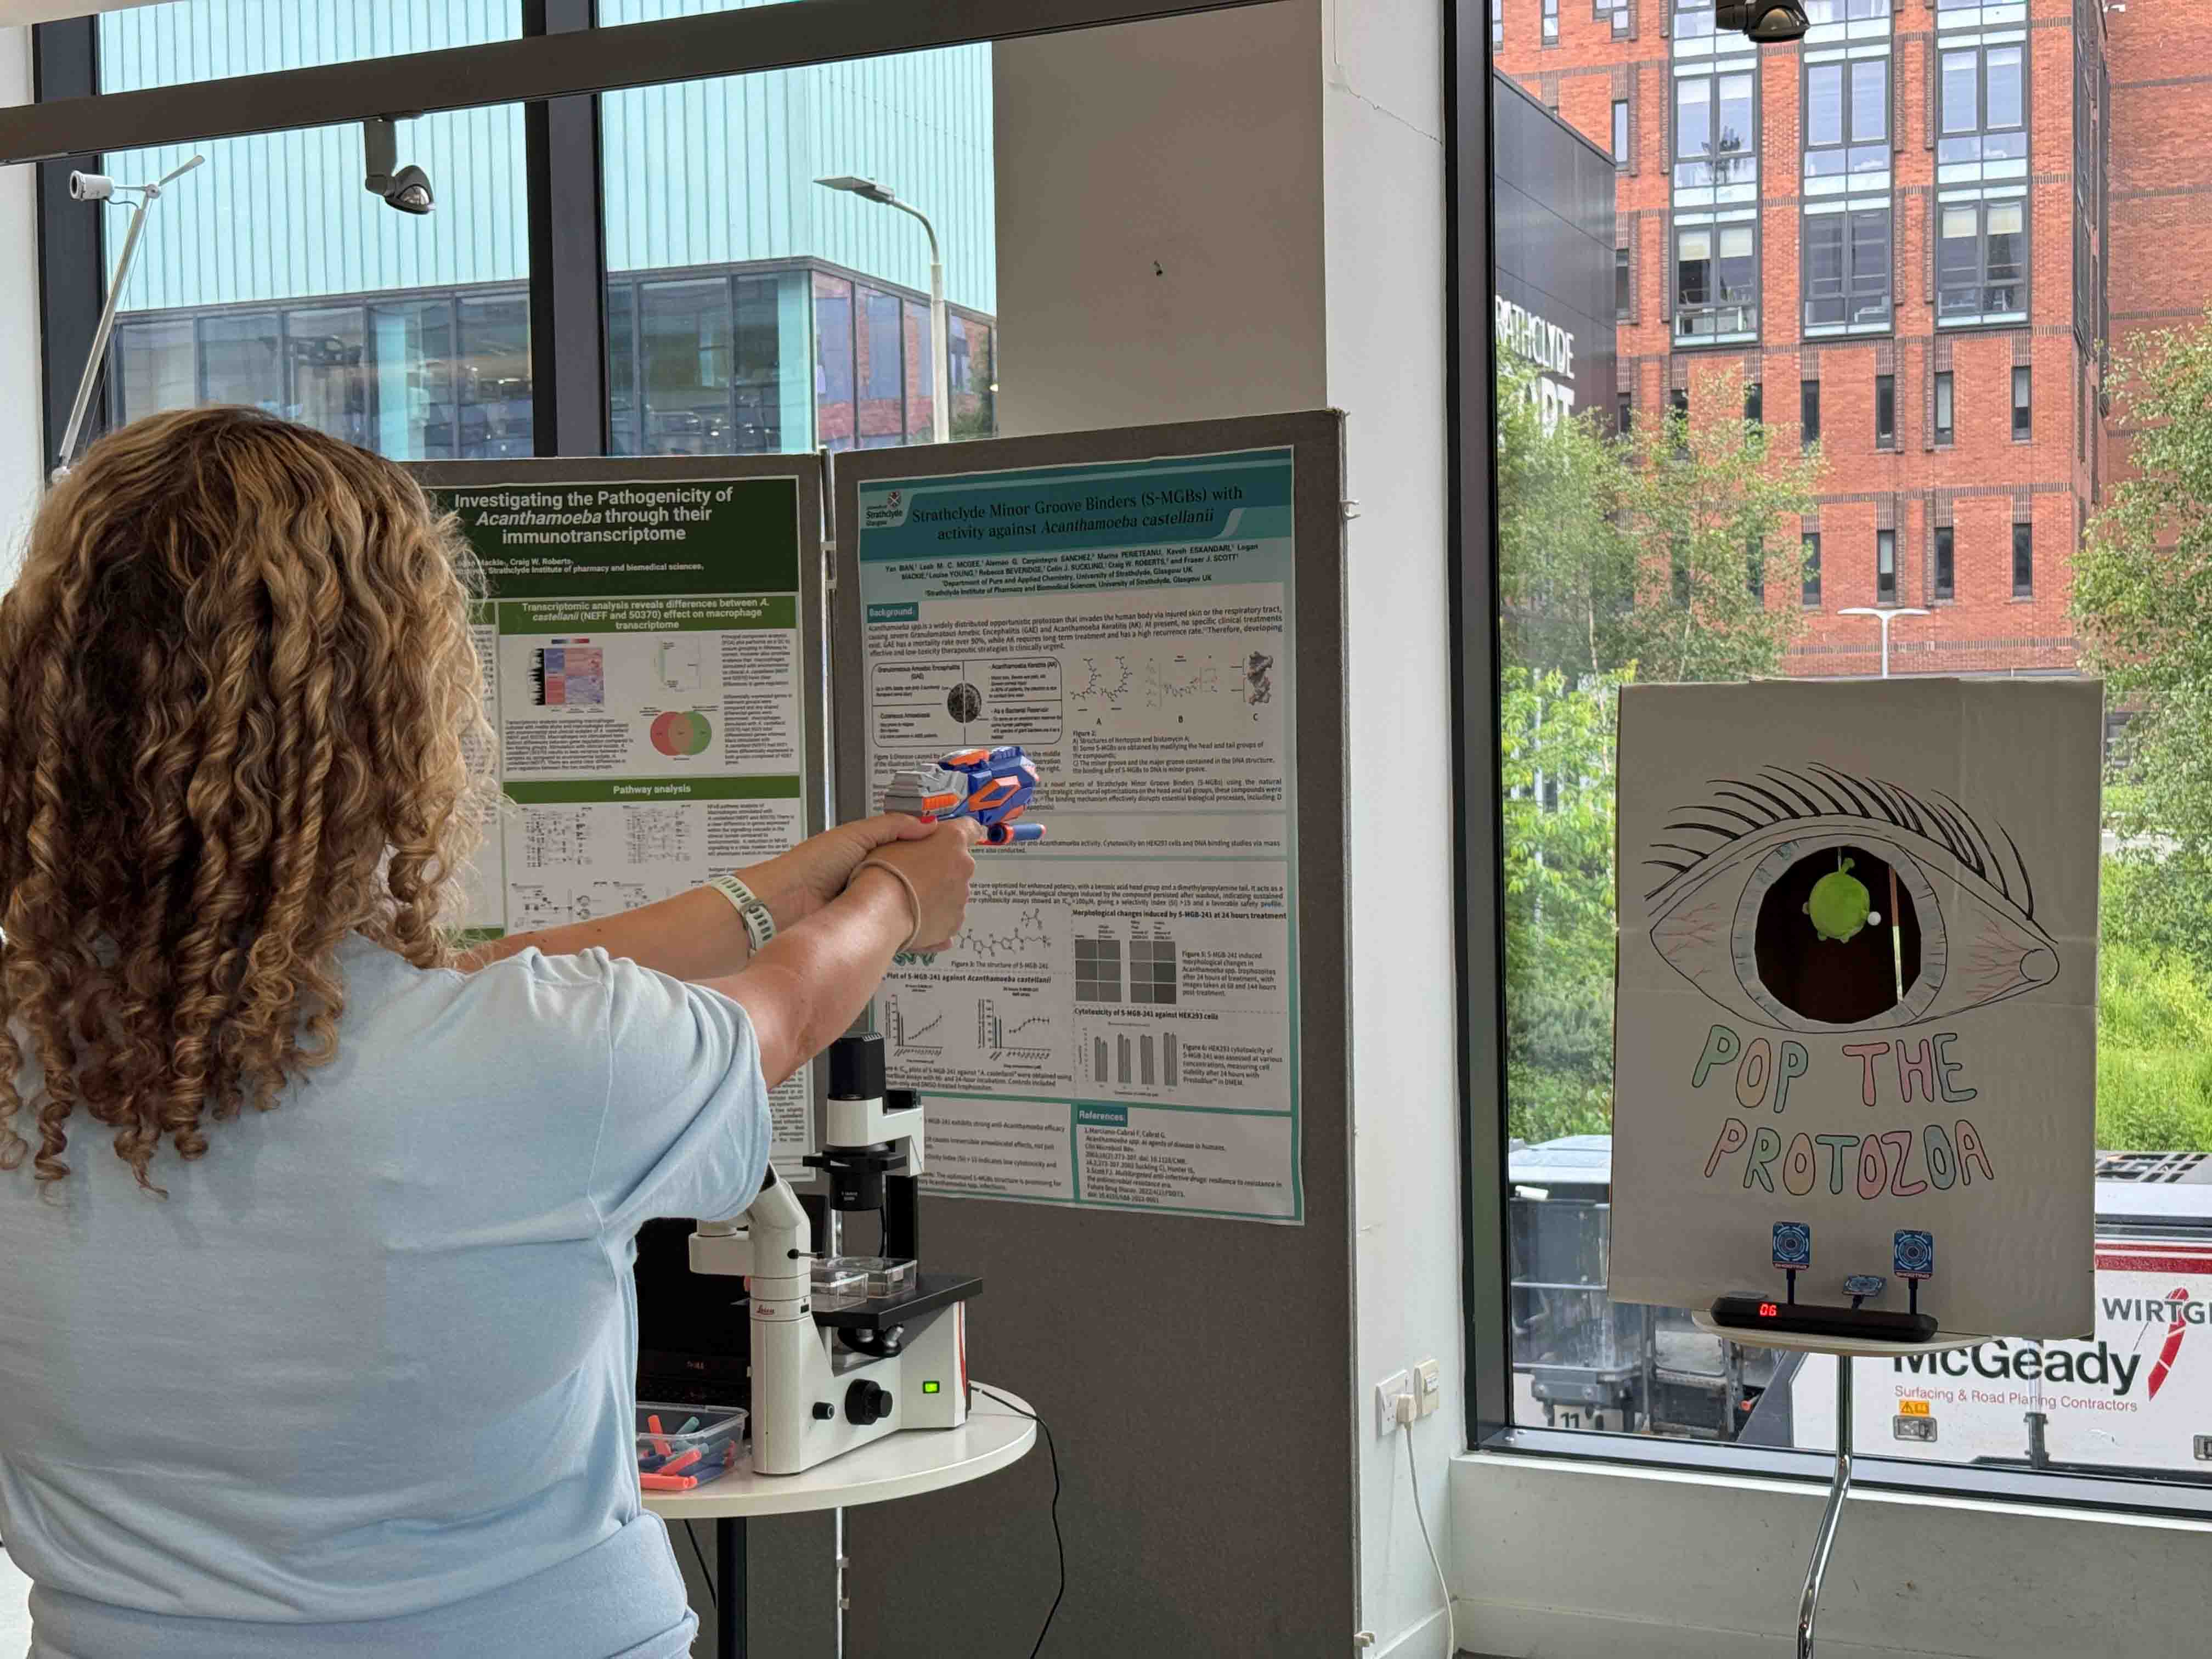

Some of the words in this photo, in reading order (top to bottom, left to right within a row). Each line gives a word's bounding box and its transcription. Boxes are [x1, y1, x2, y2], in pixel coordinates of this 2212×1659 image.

[454, 492, 563, 511] Investigating
[567, 490, 593, 505] the
[597, 488, 712, 508] Pathogenicity
[715, 488, 733, 503] of
[912, 505, 986, 523] Strathclyde
[990, 503, 1029, 517] Minor
[1035, 500, 1082, 514] Groove
[1085, 495, 1137, 511] Binders
[1141, 489, 1207, 509] (S-MGBs)
[1212, 487, 1243, 502] with
[475, 509, 602, 526] Acanthamoeba
[605, 507, 669, 526] through
[673, 506, 713, 522] their
[938, 525, 983, 540] activity
[989, 522, 1036, 539] against
[1041, 515, 1138, 533] Acanthamoeba
[1142, 510, 1215, 527] castellanii
[502, 527, 686, 545] immunotranscriptome
[573, 565, 609, 574] pharmacy
[522, 601, 589, 612] Transcriptomic
[591, 600, 629, 611] analysis
[631, 600, 664, 608] reveals
[666, 599, 718, 608] differences
[719, 599, 758, 607] between
[759, 597, 770, 607] A.
[580, 611, 607, 621] (NEFF
[609, 611, 626, 619] and
[629, 610, 661, 620] 50370)
[663, 610, 691, 618] effect
[706, 608, 762, 619] macrophage
[869, 607, 913, 618] Background
[954, 618, 988, 627] distributed
[1031, 616, 1063, 626] protozoan
[1079, 613, 1102, 622] invades
[1137, 611, 1153, 620] body
[1165, 609, 1188, 618] injured
[1188, 608, 1203, 617] skin
[1224, 607, 1261, 617] respiratory
[1263, 606, 1282, 614] tract,
[615, 620, 680, 630] transcriptome
[1040, 624, 1052, 632] and
[1193, 617, 1216, 628] specific
[1217, 616, 1242, 624] clinical
[1243, 615, 1282, 623] treatments
[1015, 634, 1042, 644] requires
[1074, 631, 1106, 640] treatment
[1107, 630, 1119, 639] and
[1137, 629, 1151, 639] high
[893, 647, 904, 655] and
[613, 785, 652, 796] Pathway
[653, 784, 691, 796] analysis
[1072, 909, 1116, 918] Morphological
[1117, 909, 1142, 919] changes
[1169, 910, 1177, 919] by
[942, 973, 967, 982] against
[967, 973, 1016, 982] Acanthamoeba
[1155, 1011, 1178, 1020] against
[1204, 1012, 1219, 1020] cells
[1691, 1024, 1809, 1113] POP
[1842, 1033, 1977, 1106] THE
[1079, 1111, 1124, 1121] References
[1704, 1118, 1994, 1199] PROTOZOA
[1760, 1304, 1776, 1316] 06
[1894, 1385, 1954, 1403] Surfacing
[1957, 1390, 1967, 1401] &
[1971, 1390, 2005, 1404] Road
[2009, 1393, 2057, 1410] Planing
[2061, 1396, 2138, 1412] Contractors
